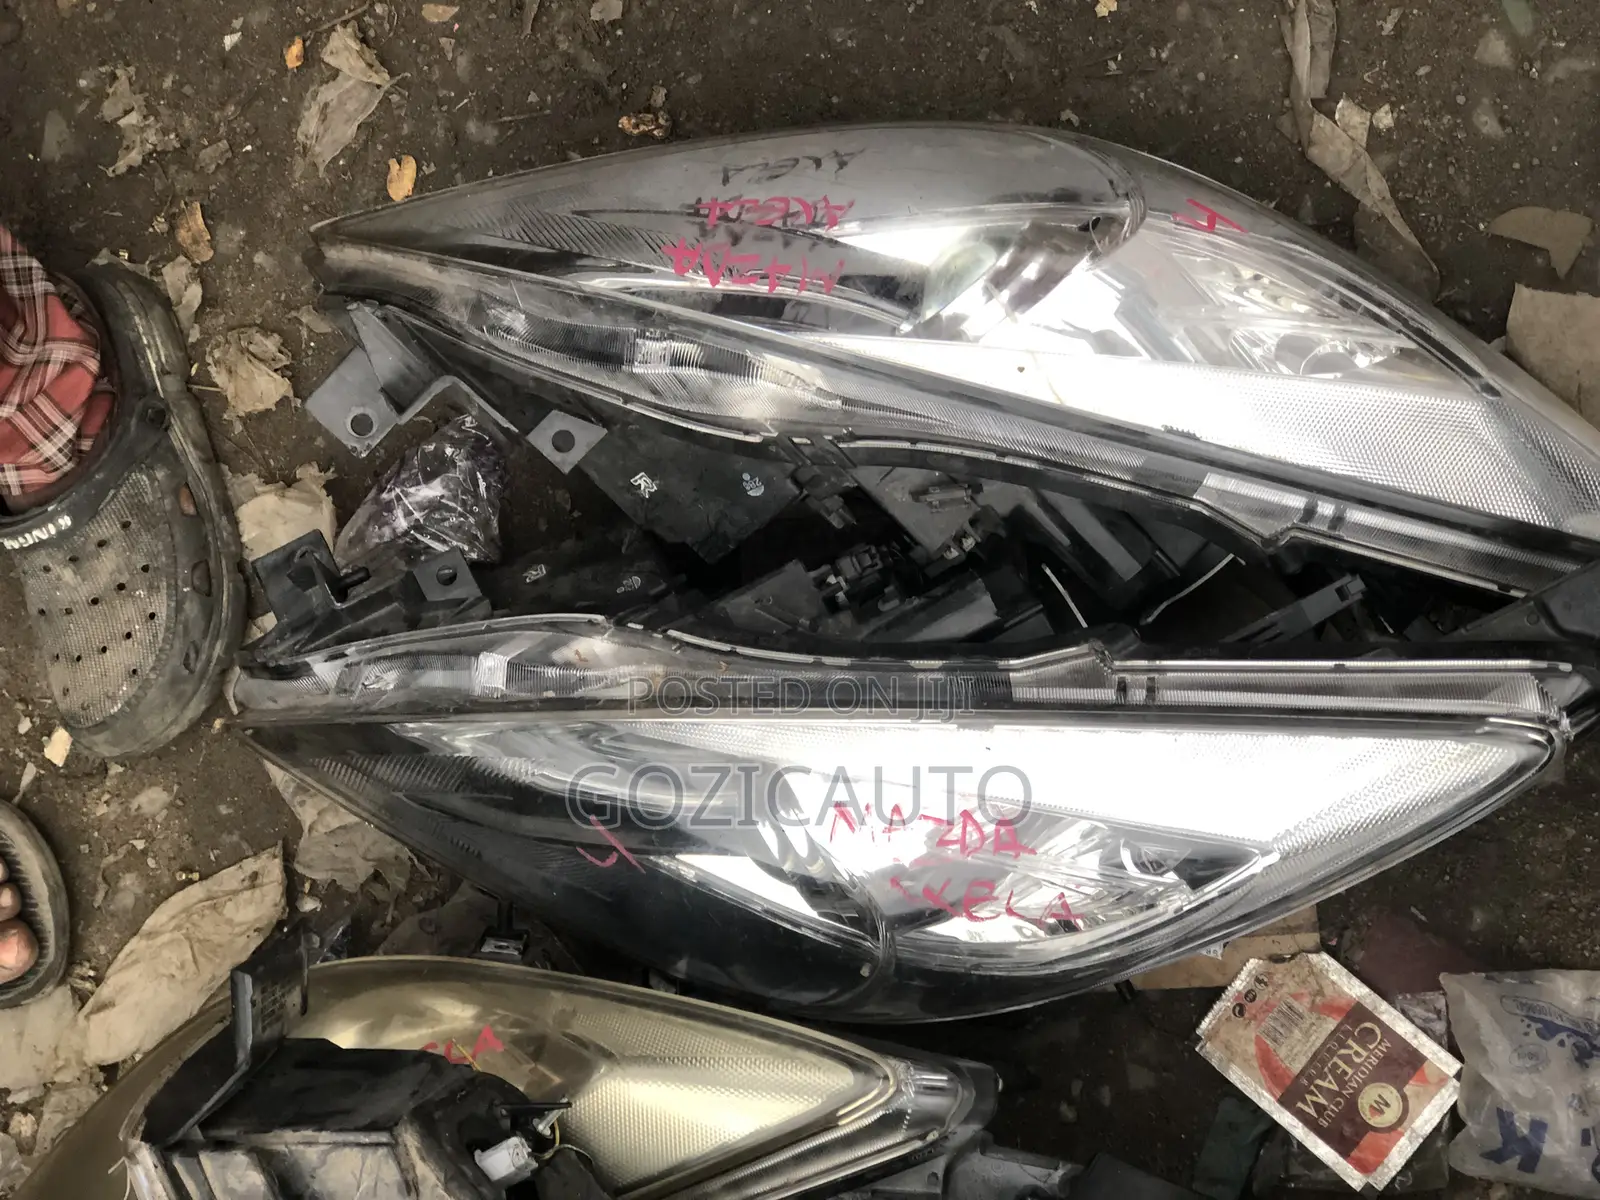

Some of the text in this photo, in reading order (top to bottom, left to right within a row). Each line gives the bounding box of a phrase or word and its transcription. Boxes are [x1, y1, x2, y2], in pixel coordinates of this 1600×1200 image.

[1295, 1021, 1382, 1119] CREAM
[1317, 1038, 1393, 1129] MERIDIAN CLUB
